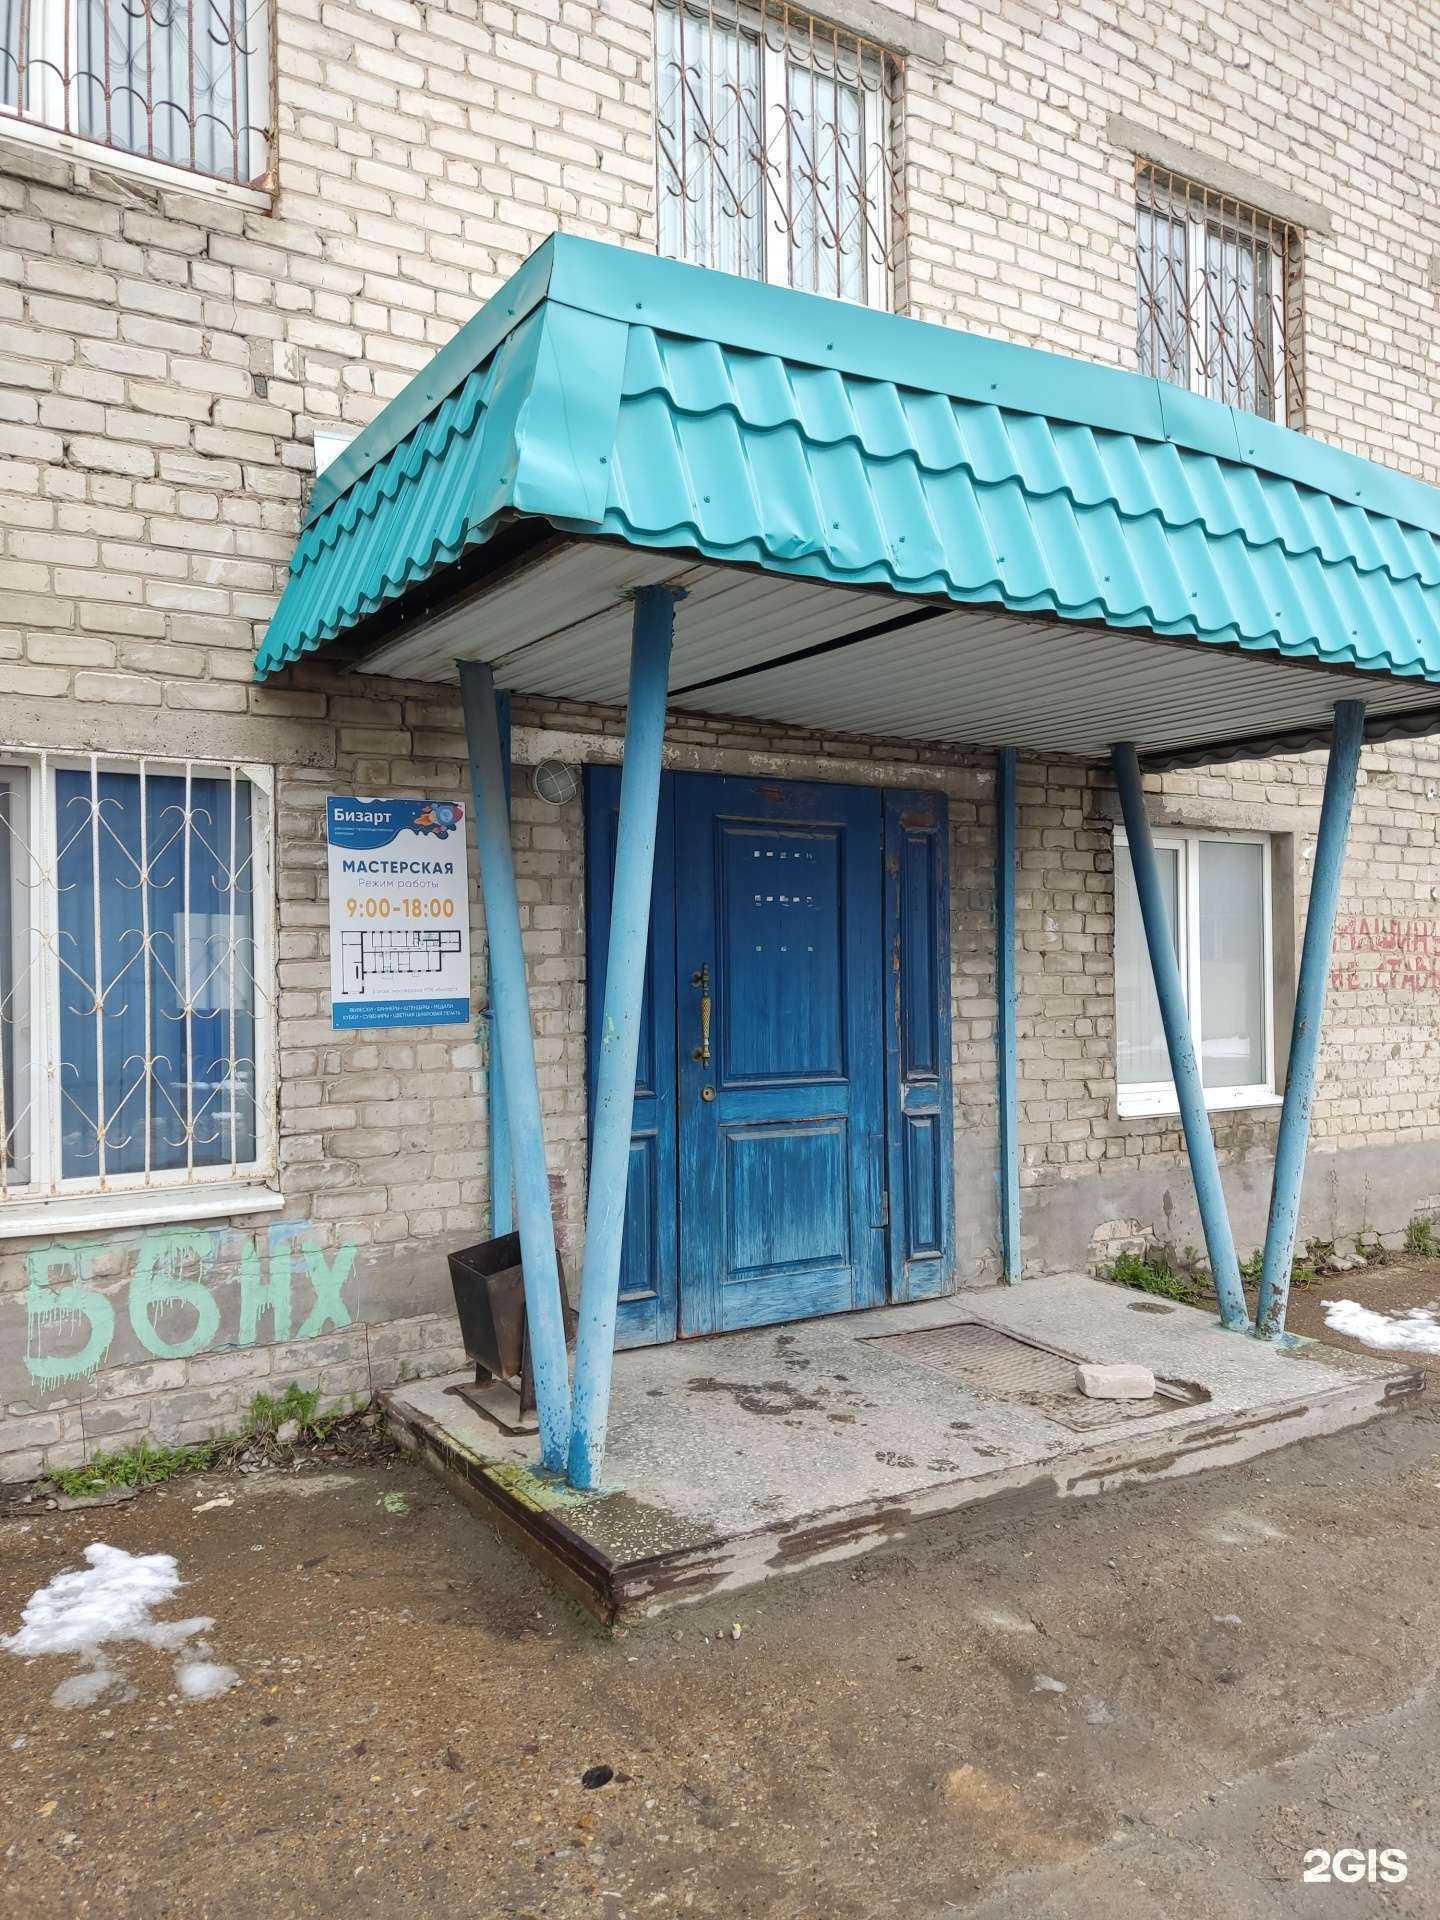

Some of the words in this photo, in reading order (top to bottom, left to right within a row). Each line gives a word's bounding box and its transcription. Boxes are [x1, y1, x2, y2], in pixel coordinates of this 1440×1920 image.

[334, 808, 391, 825] Бизарт
[342, 860, 454, 875] МАСТЕРСКАЯ
[358, 879, 394, 889] Режим
[397, 880, 440, 890] работы
[346, 897, 455, 918] 9:00-18:00
